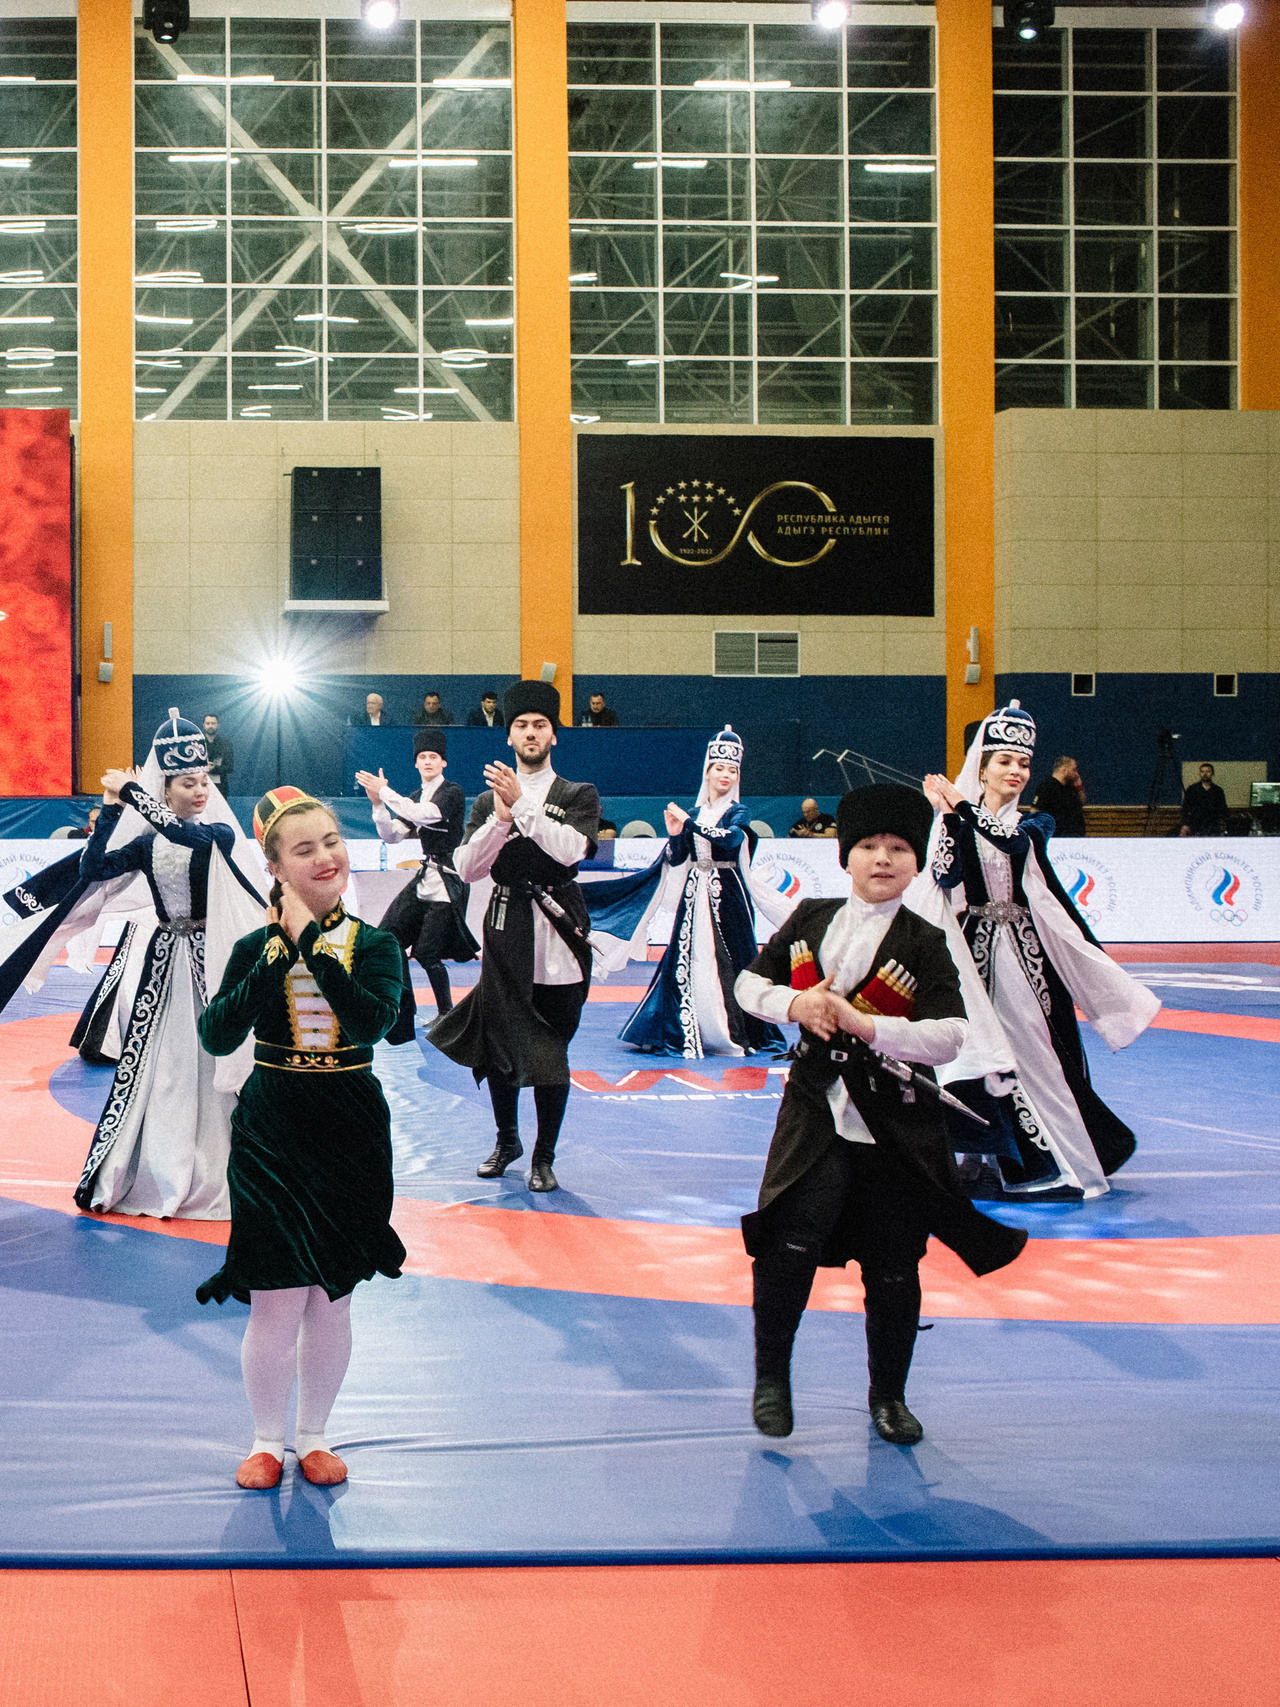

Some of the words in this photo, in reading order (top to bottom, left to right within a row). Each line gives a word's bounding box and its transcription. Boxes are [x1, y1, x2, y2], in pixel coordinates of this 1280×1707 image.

[776, 514, 846, 524] РЕСПУБЛИКА
[849, 515, 890, 525] АДЫГЕЯ
[776, 526, 816, 536] АДЫГЭ
[821, 526, 890, 536] РЕСПУБЛИК
[776, 853, 816, 876] КОМИТЕТ
[1070, 852, 1109, 875] КОМИТЕТ
[1214, 851, 1255, 874] КОМИТЕТ
[590, 1092, 785, 1101] WRESTLI
